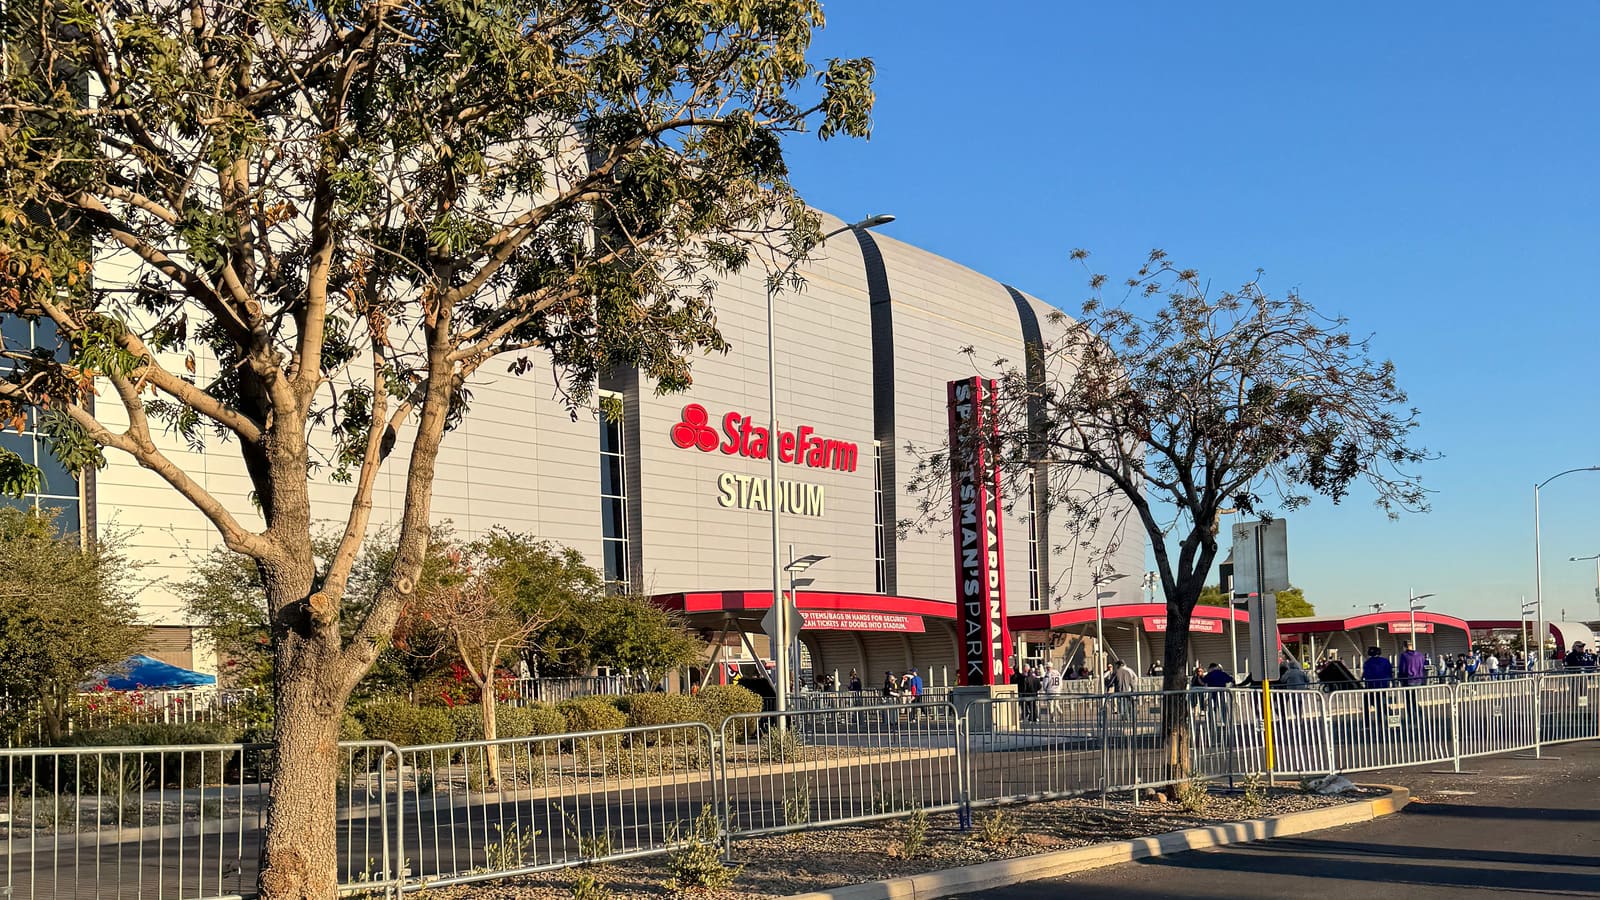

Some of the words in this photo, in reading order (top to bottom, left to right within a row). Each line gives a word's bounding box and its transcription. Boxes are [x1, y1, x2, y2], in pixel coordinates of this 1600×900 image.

[871, 614, 883, 622] FOR
[986, 509, 1003, 676] CARDINALS
[964, 602, 984, 677] PARK
